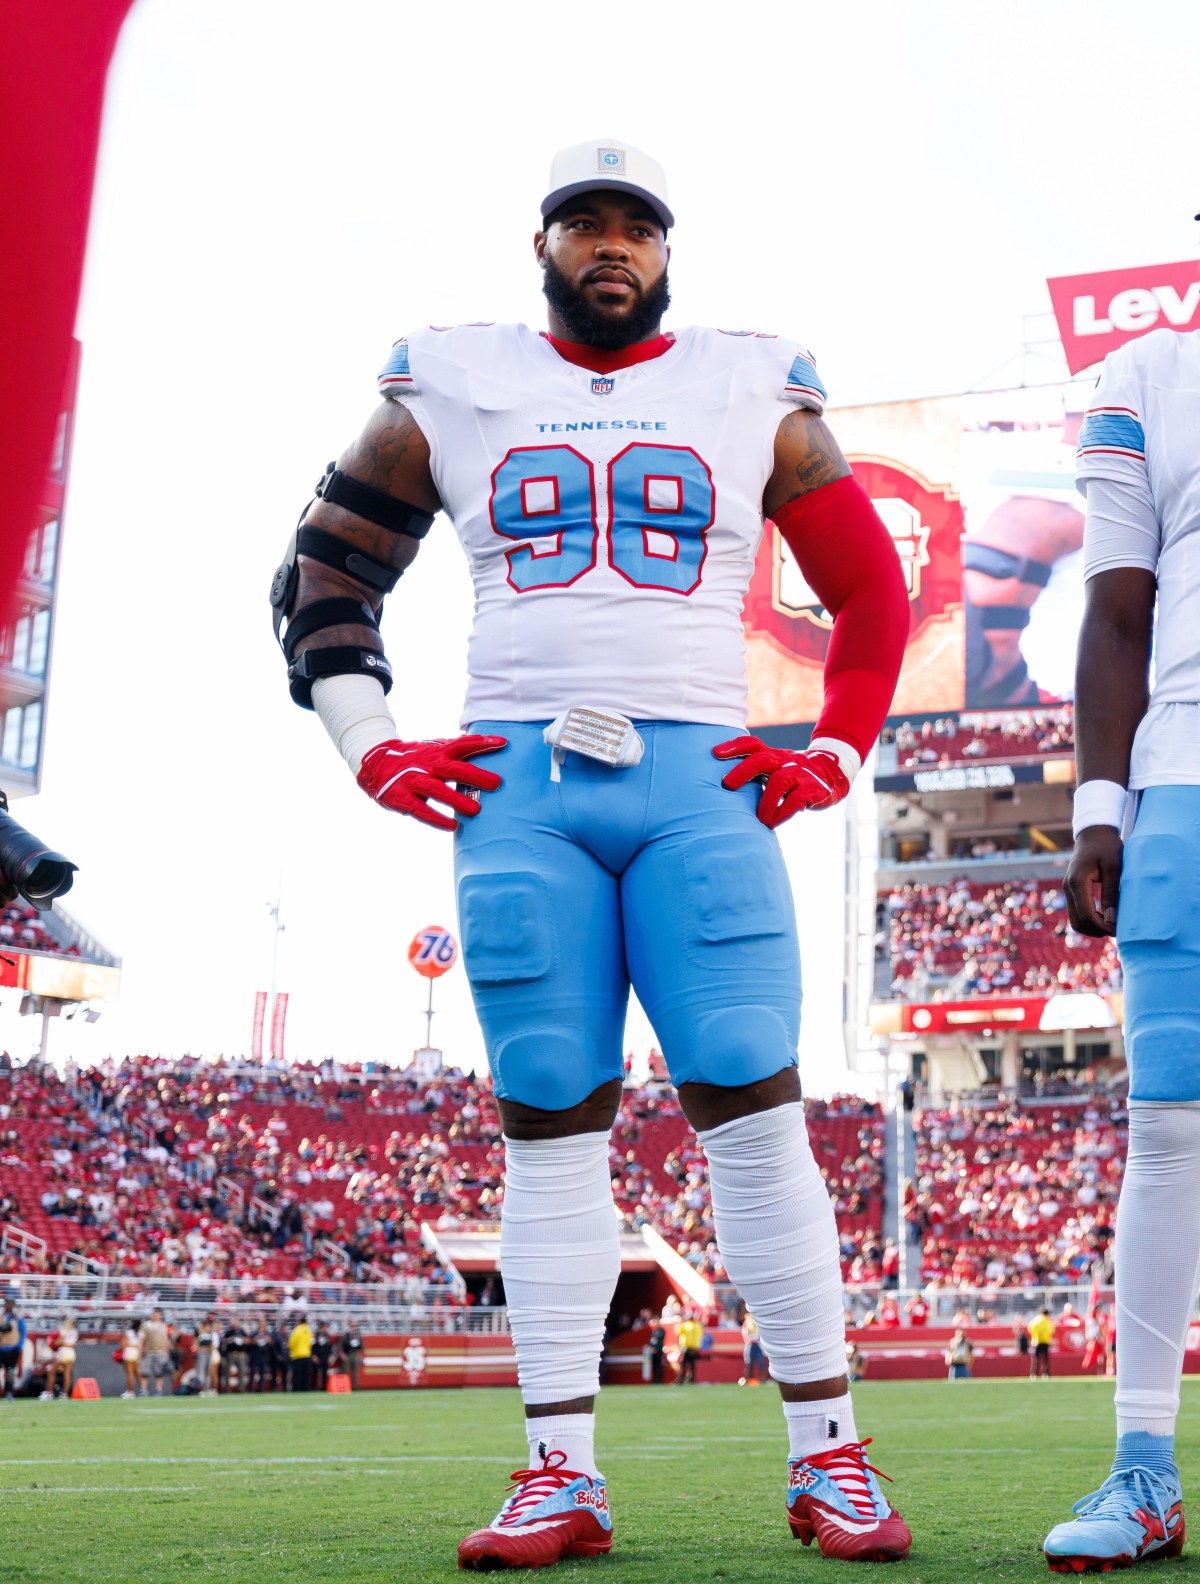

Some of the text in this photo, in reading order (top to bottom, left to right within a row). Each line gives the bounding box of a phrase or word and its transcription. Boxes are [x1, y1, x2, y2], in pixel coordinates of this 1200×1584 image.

[535, 420, 667, 433] TENNESSEE
[489, 442, 716, 596] 98
[420, 933, 455, 963] 76
